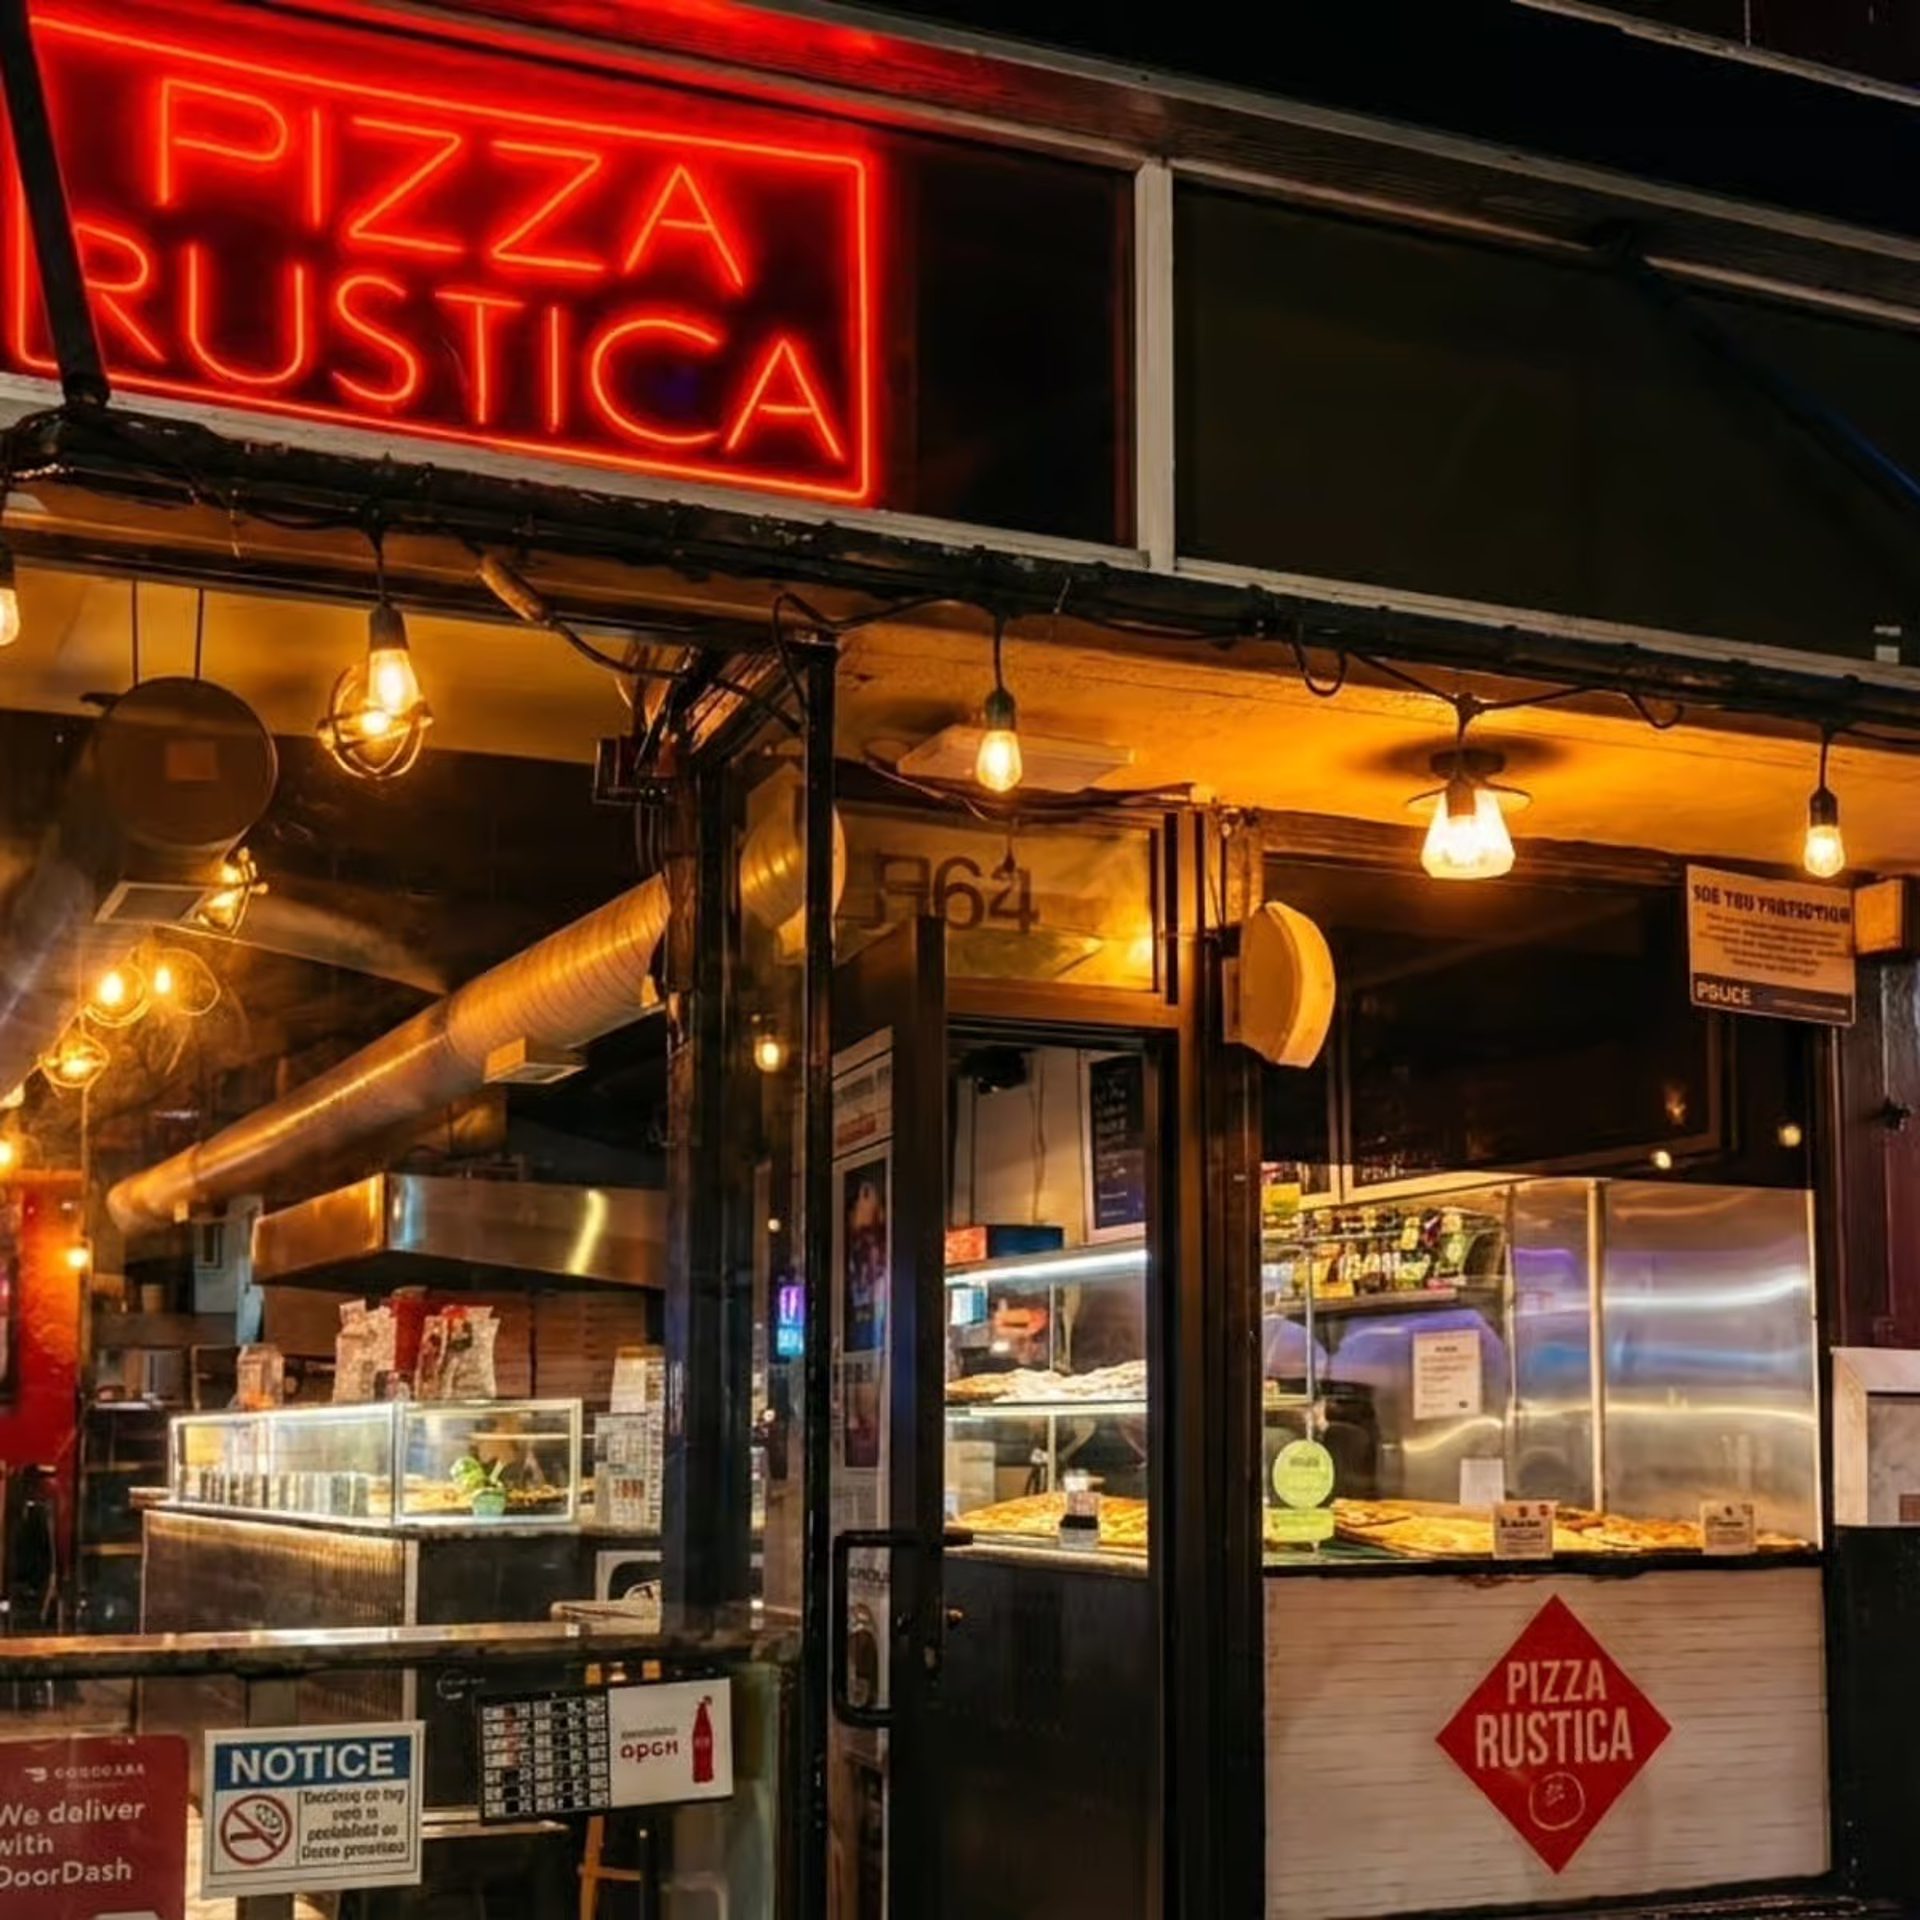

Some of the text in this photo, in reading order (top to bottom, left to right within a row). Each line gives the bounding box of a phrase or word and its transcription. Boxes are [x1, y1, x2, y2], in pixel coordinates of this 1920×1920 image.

[156, 76, 747, 291] PIZZA
[70, 221, 847, 462] RUSTICA
[1506, 1659, 1608, 1705] PIZZA
[230, 1742, 396, 1785] NOTICE
[1475, 1706, 1634, 1769] RUSTICA
[0, 1799, 146, 1827] We deliver
